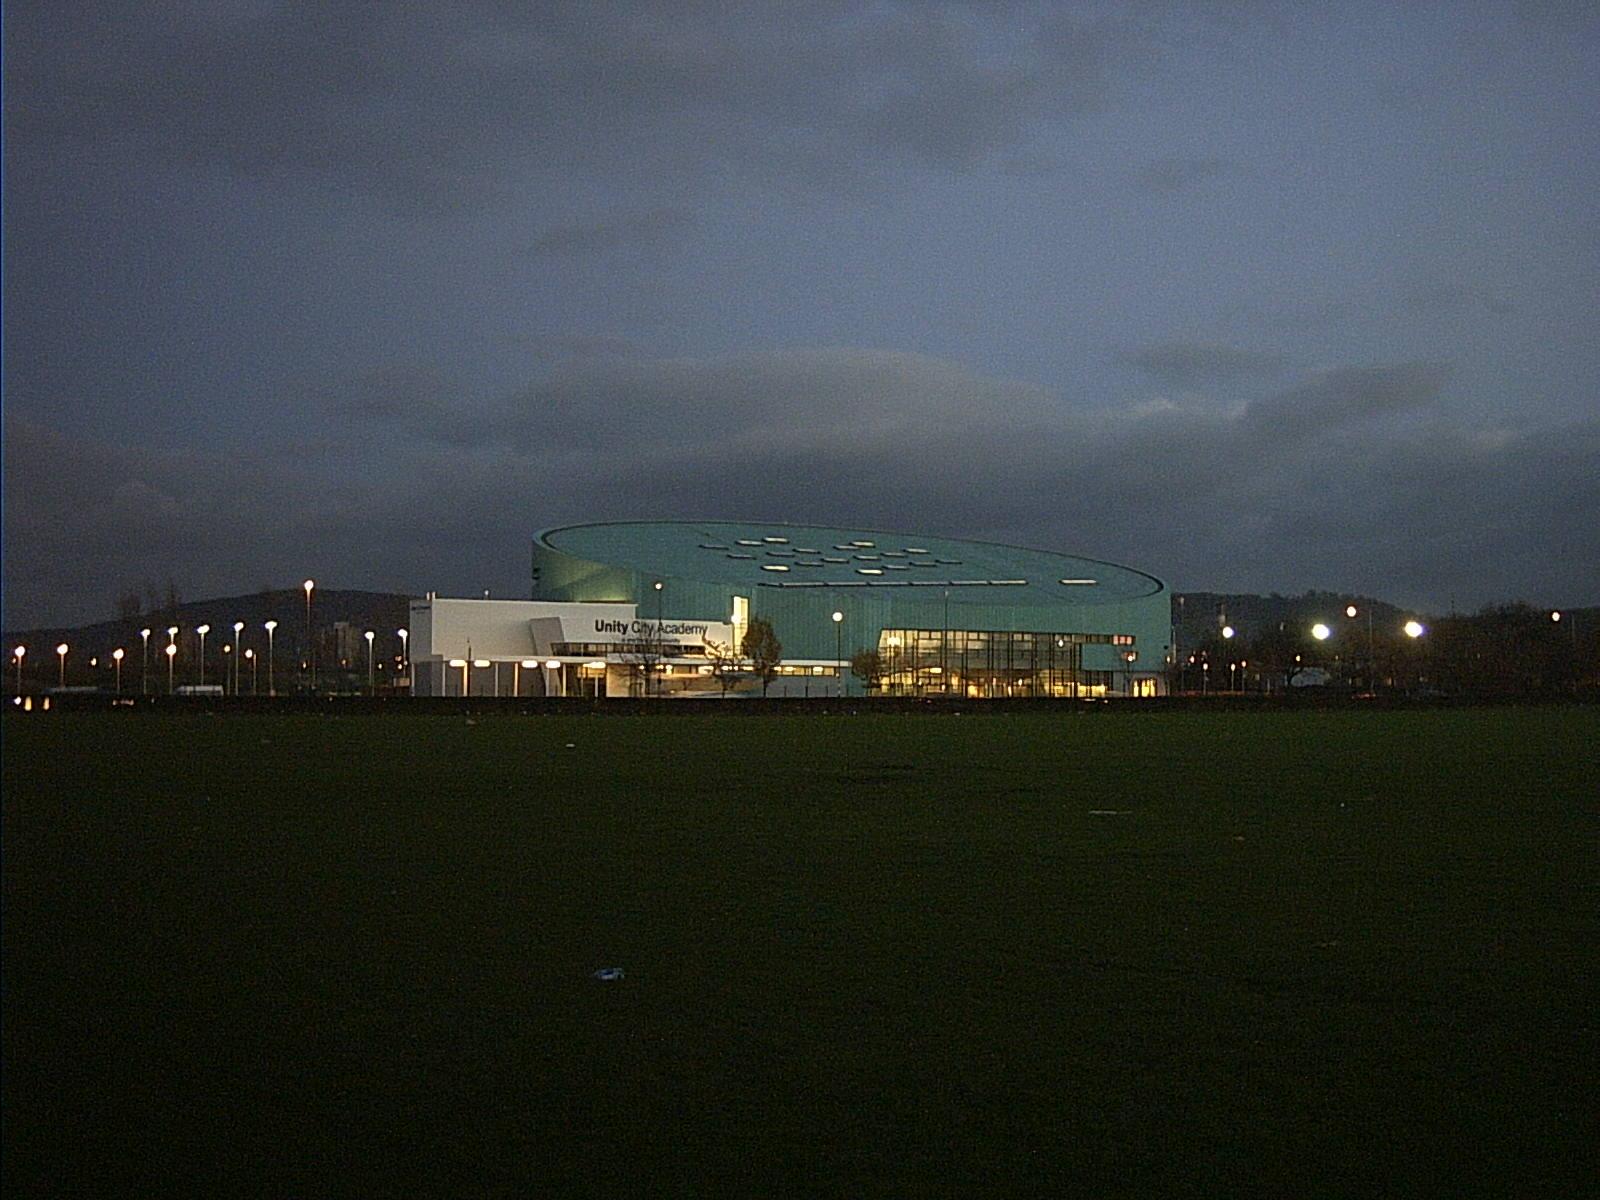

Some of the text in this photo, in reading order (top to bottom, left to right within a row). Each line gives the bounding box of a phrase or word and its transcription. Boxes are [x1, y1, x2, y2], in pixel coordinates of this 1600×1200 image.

[595, 620, 708, 637] Unity City Academy
